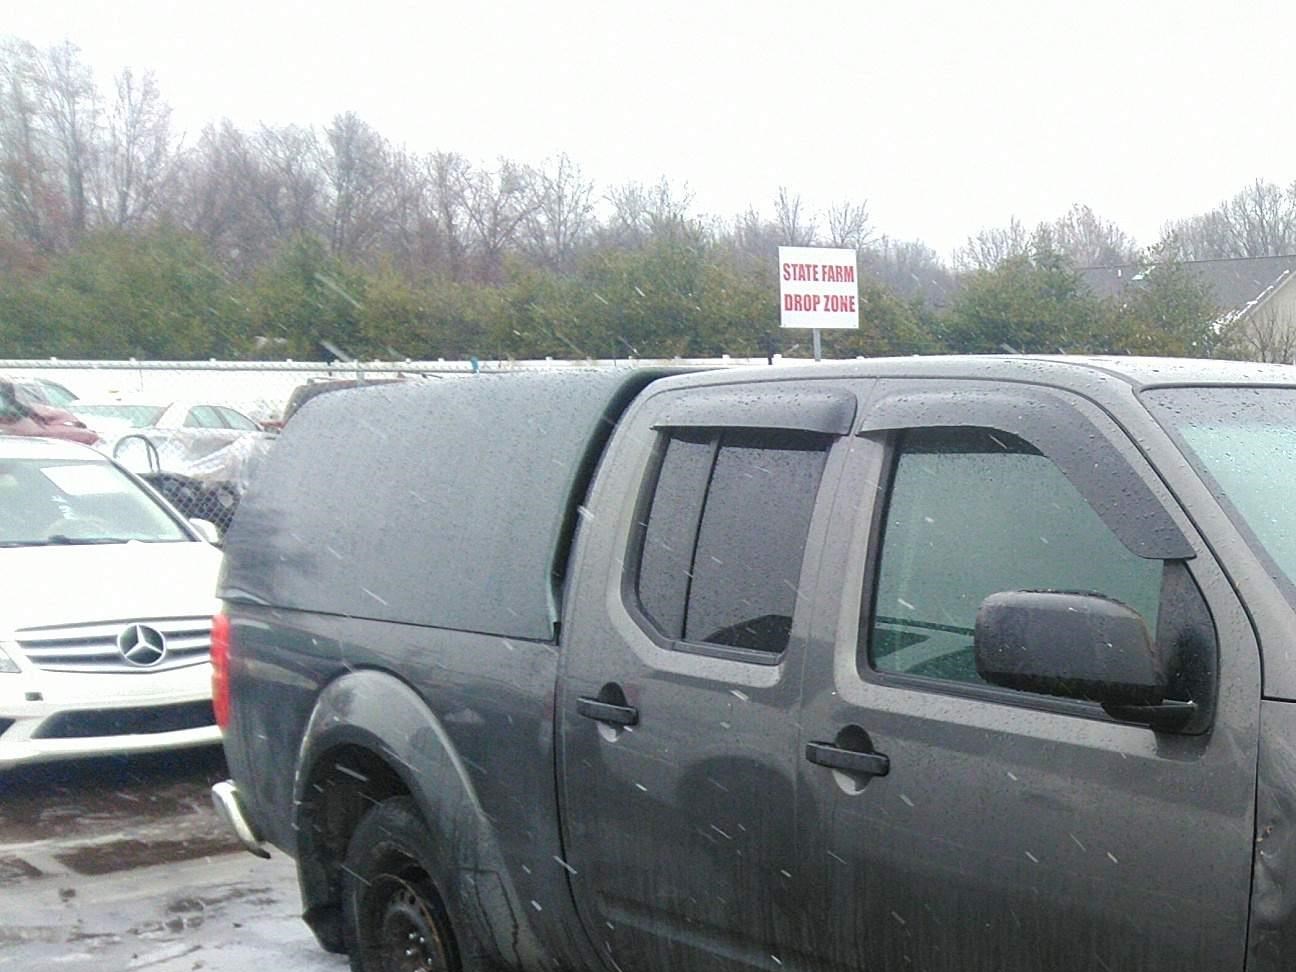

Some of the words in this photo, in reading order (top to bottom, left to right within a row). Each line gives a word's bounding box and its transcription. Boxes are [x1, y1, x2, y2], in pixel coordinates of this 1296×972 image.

[783, 263, 819, 282] STATE
[822, 265, 855, 283] FARM
[784, 294, 820, 311] DROP
[823, 295, 856, 313] ZONE
